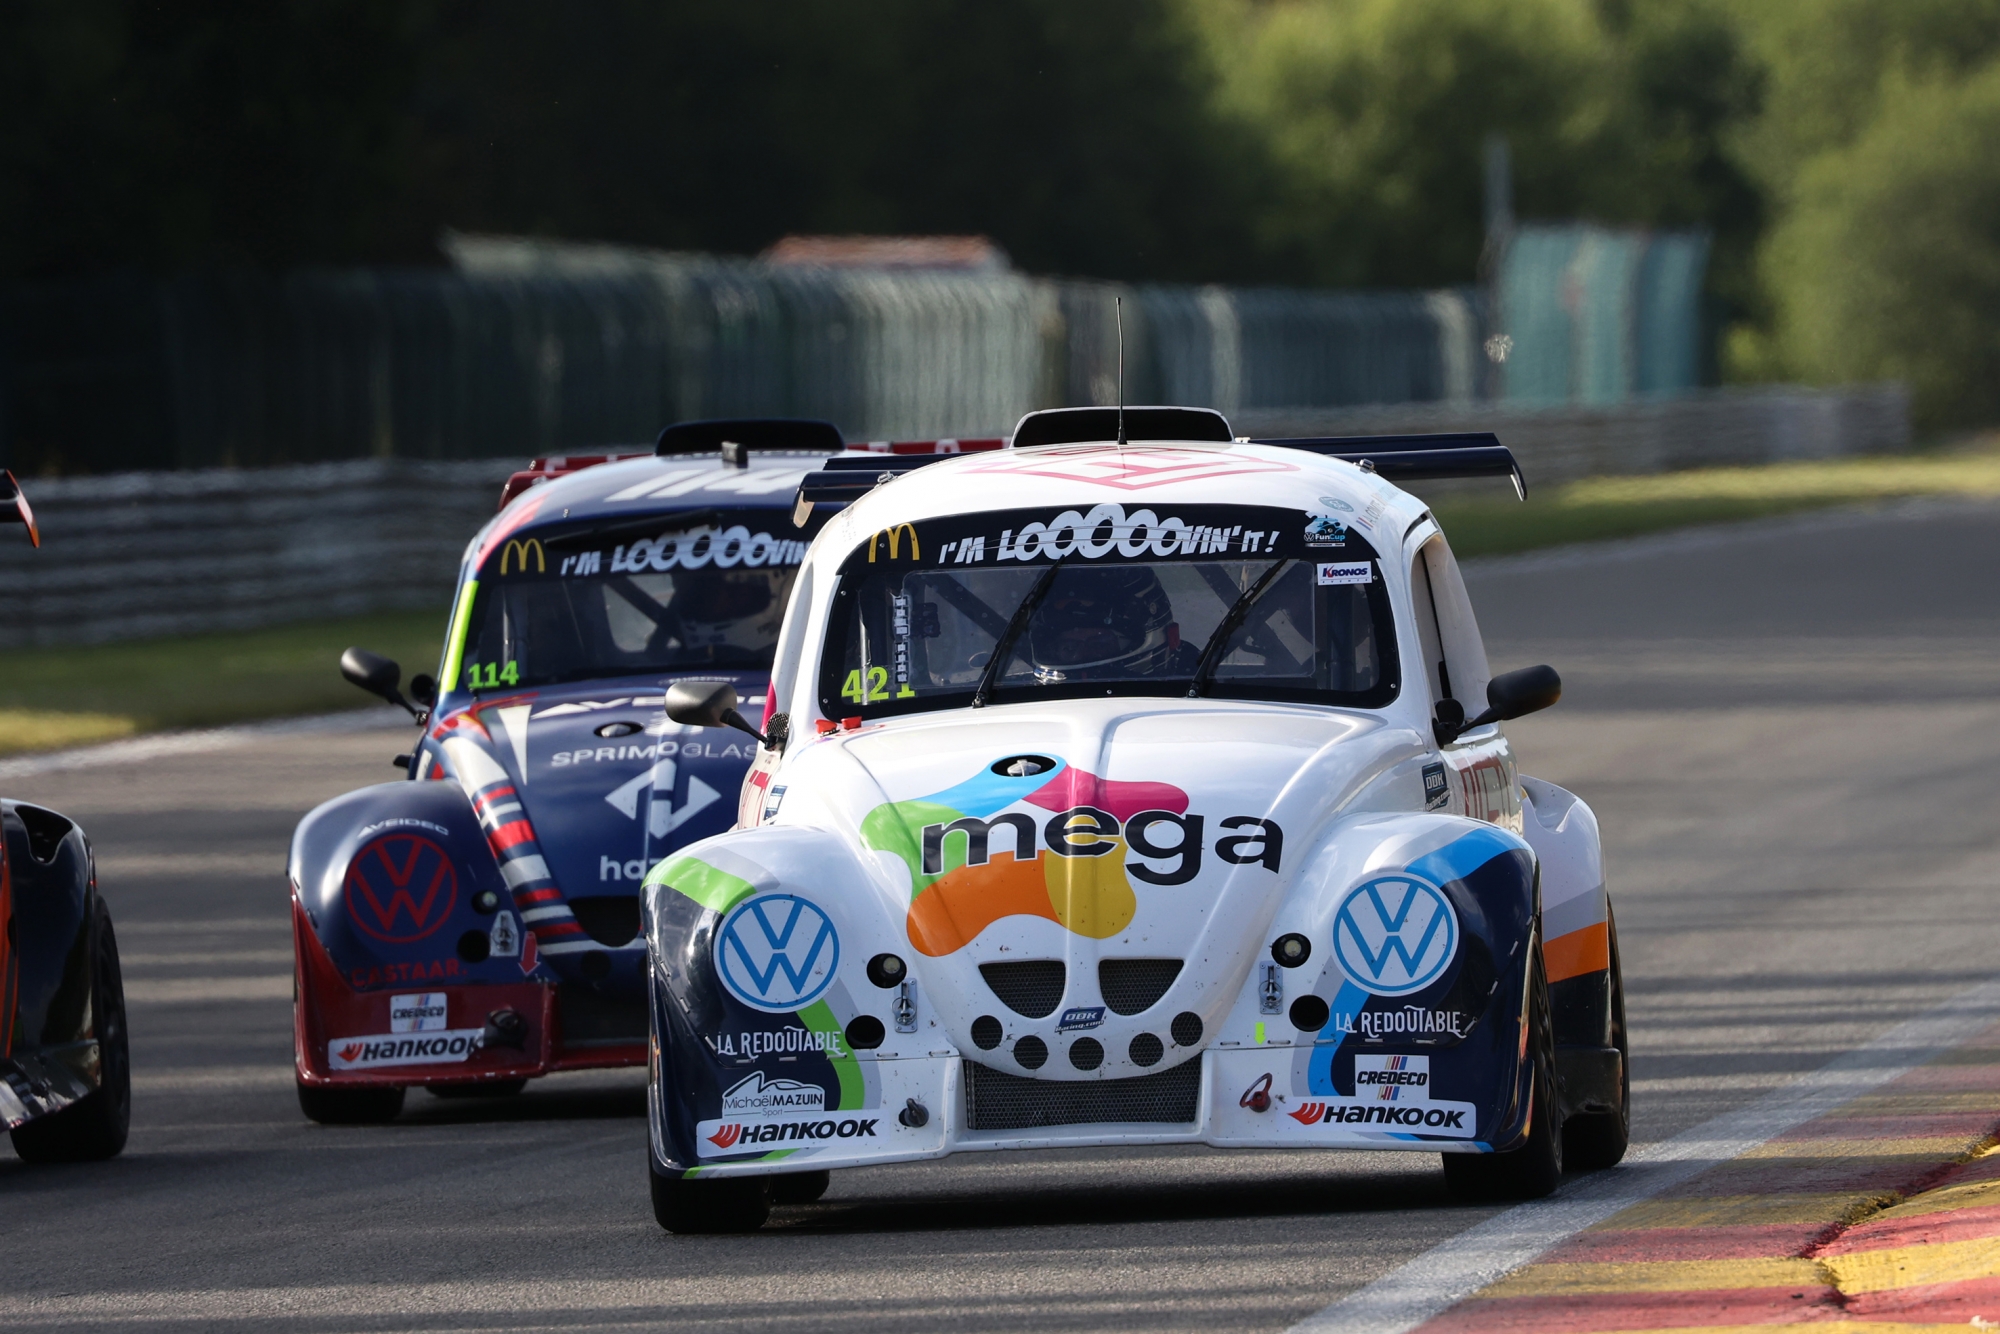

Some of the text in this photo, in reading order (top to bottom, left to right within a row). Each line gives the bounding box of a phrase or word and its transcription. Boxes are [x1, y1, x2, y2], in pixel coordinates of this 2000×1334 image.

[1315, 533, 1345, 543] FunCup
[938, 536, 985, 564] I'M
[560, 551, 601, 576] I'M
[1323, 565, 1368, 578] KRONOS
[468, 660, 520, 689] 114
[1425, 772, 1444, 790] DDK
[921, 806, 1284, 886] mega
[392, 1005, 445, 1020] CREDECO
[1336, 1005, 1467, 1038] LA REDOUTABLE
[717, 1025, 847, 1059] LA REDOUTABLE
[1356, 1070, 1428, 1086] CREDECO
[762, 1108, 783, 1118] Sport
